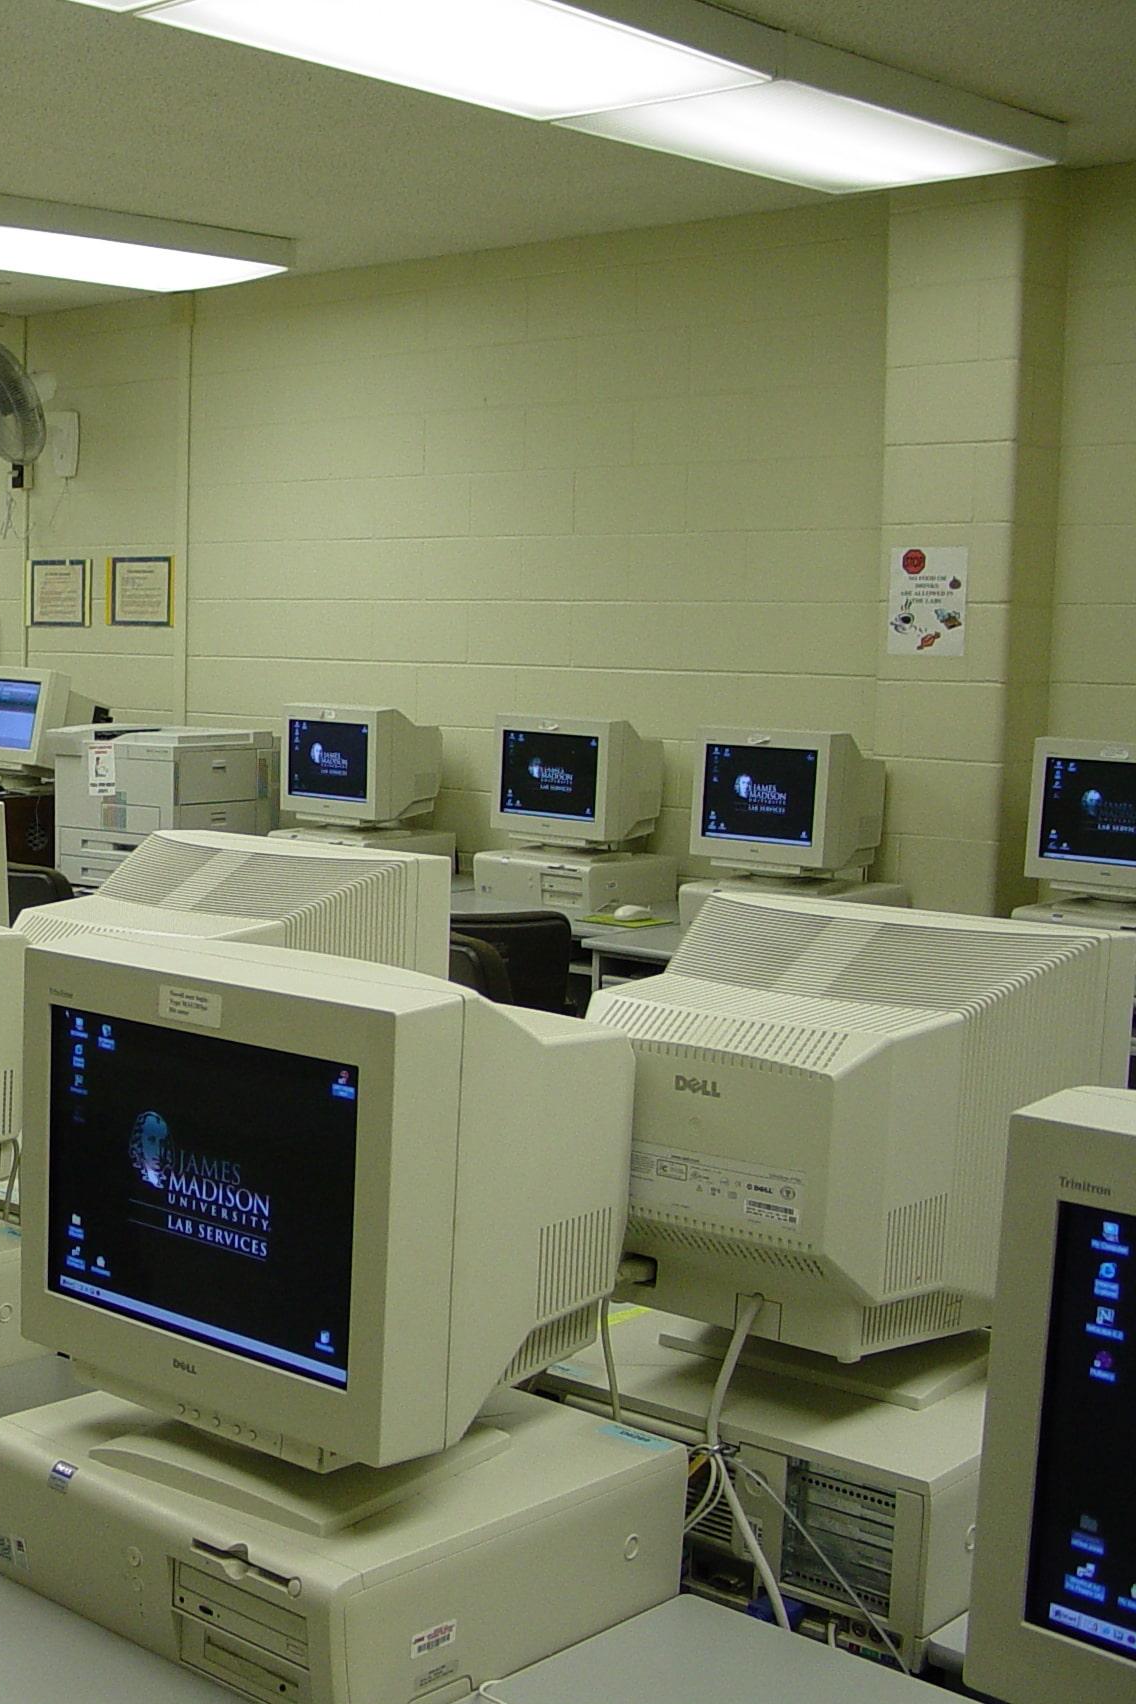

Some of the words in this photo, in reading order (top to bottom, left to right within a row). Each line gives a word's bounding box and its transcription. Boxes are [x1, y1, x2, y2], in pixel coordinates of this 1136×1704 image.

[749, 791, 786, 800] MADISON
[675, 1075, 720, 1098] DELL
[179, 1150, 241, 1186] JAMES
[168, 1171, 270, 1217] MADISON
[754, 1185, 773, 1194] DELL
[1059, 1176, 1111, 1196] Trinitron
[168, 1193, 270, 1232] UNIVERSITY
[167, 1215, 193, 1235] LAB
[198, 1224, 268, 1257] SERVICES
[173, 1358, 197, 1375] DELL
